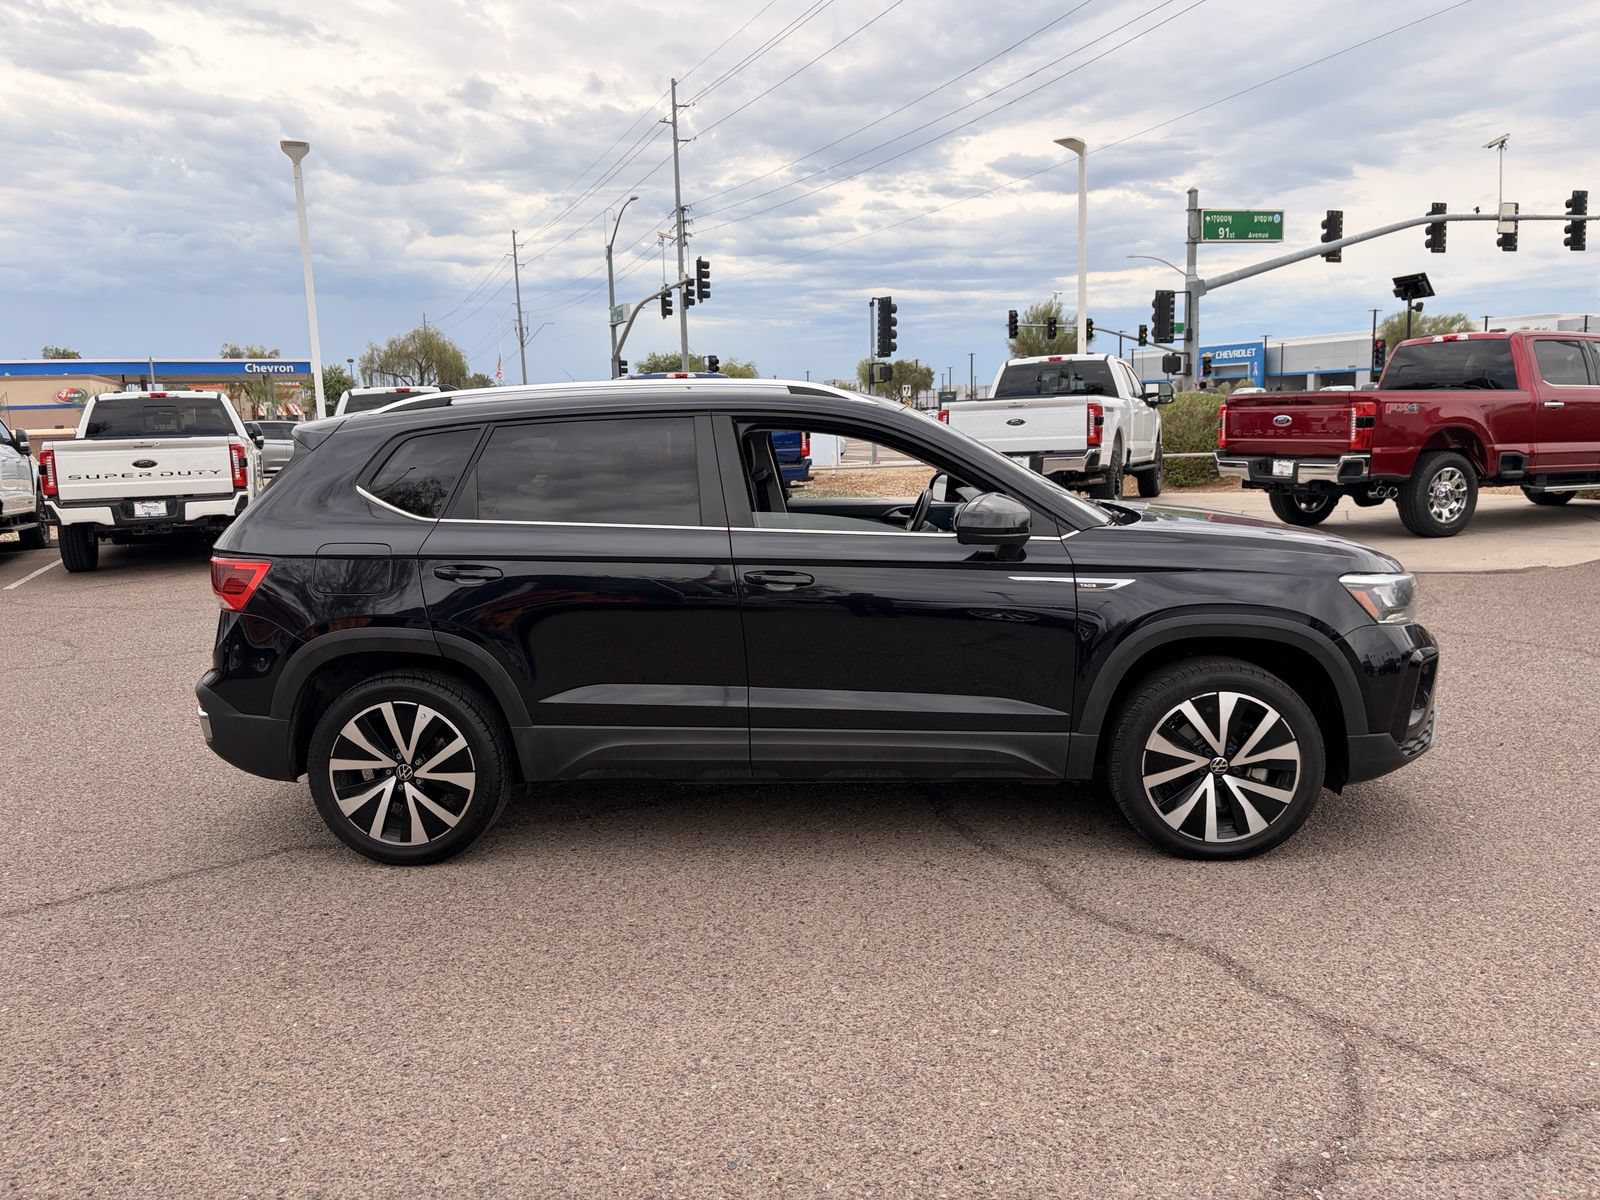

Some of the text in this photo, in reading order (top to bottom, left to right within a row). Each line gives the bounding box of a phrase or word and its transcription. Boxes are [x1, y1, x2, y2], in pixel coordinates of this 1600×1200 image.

[1218, 227, 1235, 238] 91st
[1215, 348, 1256, 359] CHEVROLET
[244, 363, 294, 373] Chevron
[1385, 403, 1418, 414] FX4
[68, 469, 222, 480] SUPER DUTY
